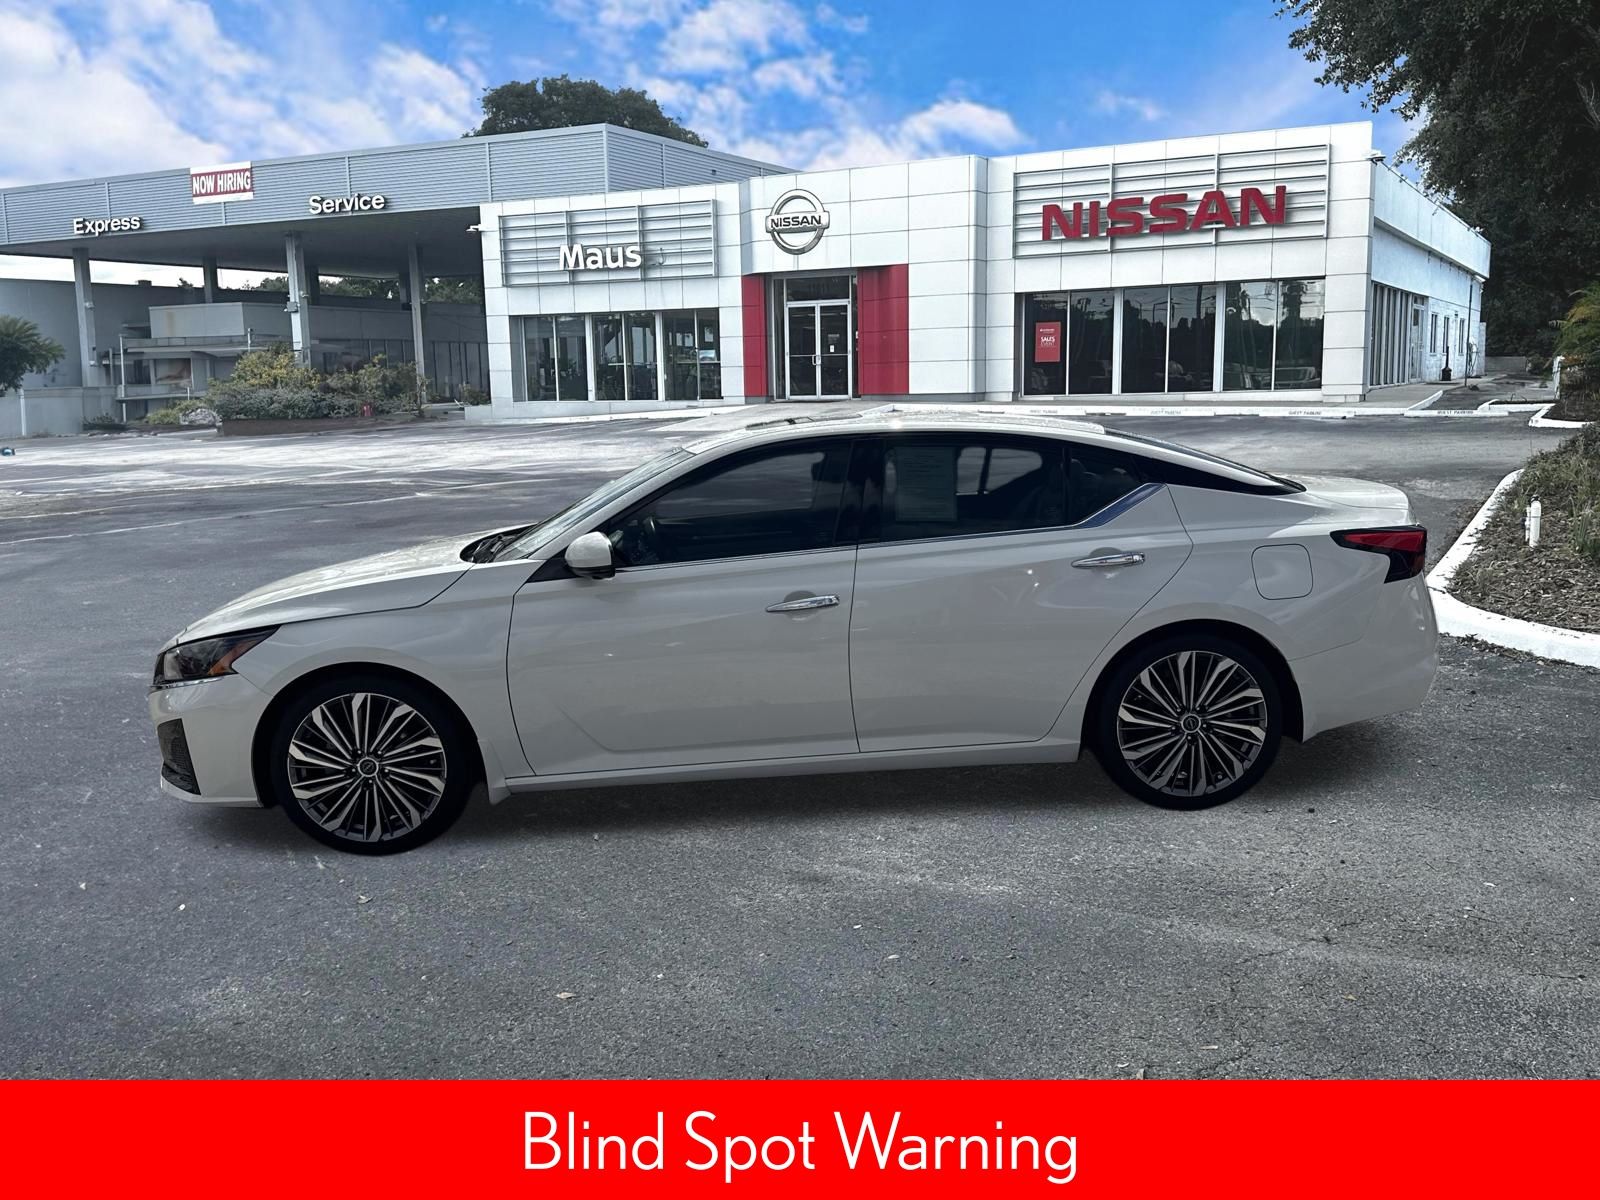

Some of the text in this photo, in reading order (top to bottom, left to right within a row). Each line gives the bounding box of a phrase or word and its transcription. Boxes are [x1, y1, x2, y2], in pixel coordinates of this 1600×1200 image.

[192, 171, 251, 195] NOW HIRING
[309, 193, 385, 215] Service
[1042, 185, 1287, 241] NISSAN
[73, 215, 141, 237] Express
[770, 215, 822, 229] NISSAN
[559, 243, 642, 270] Maus
